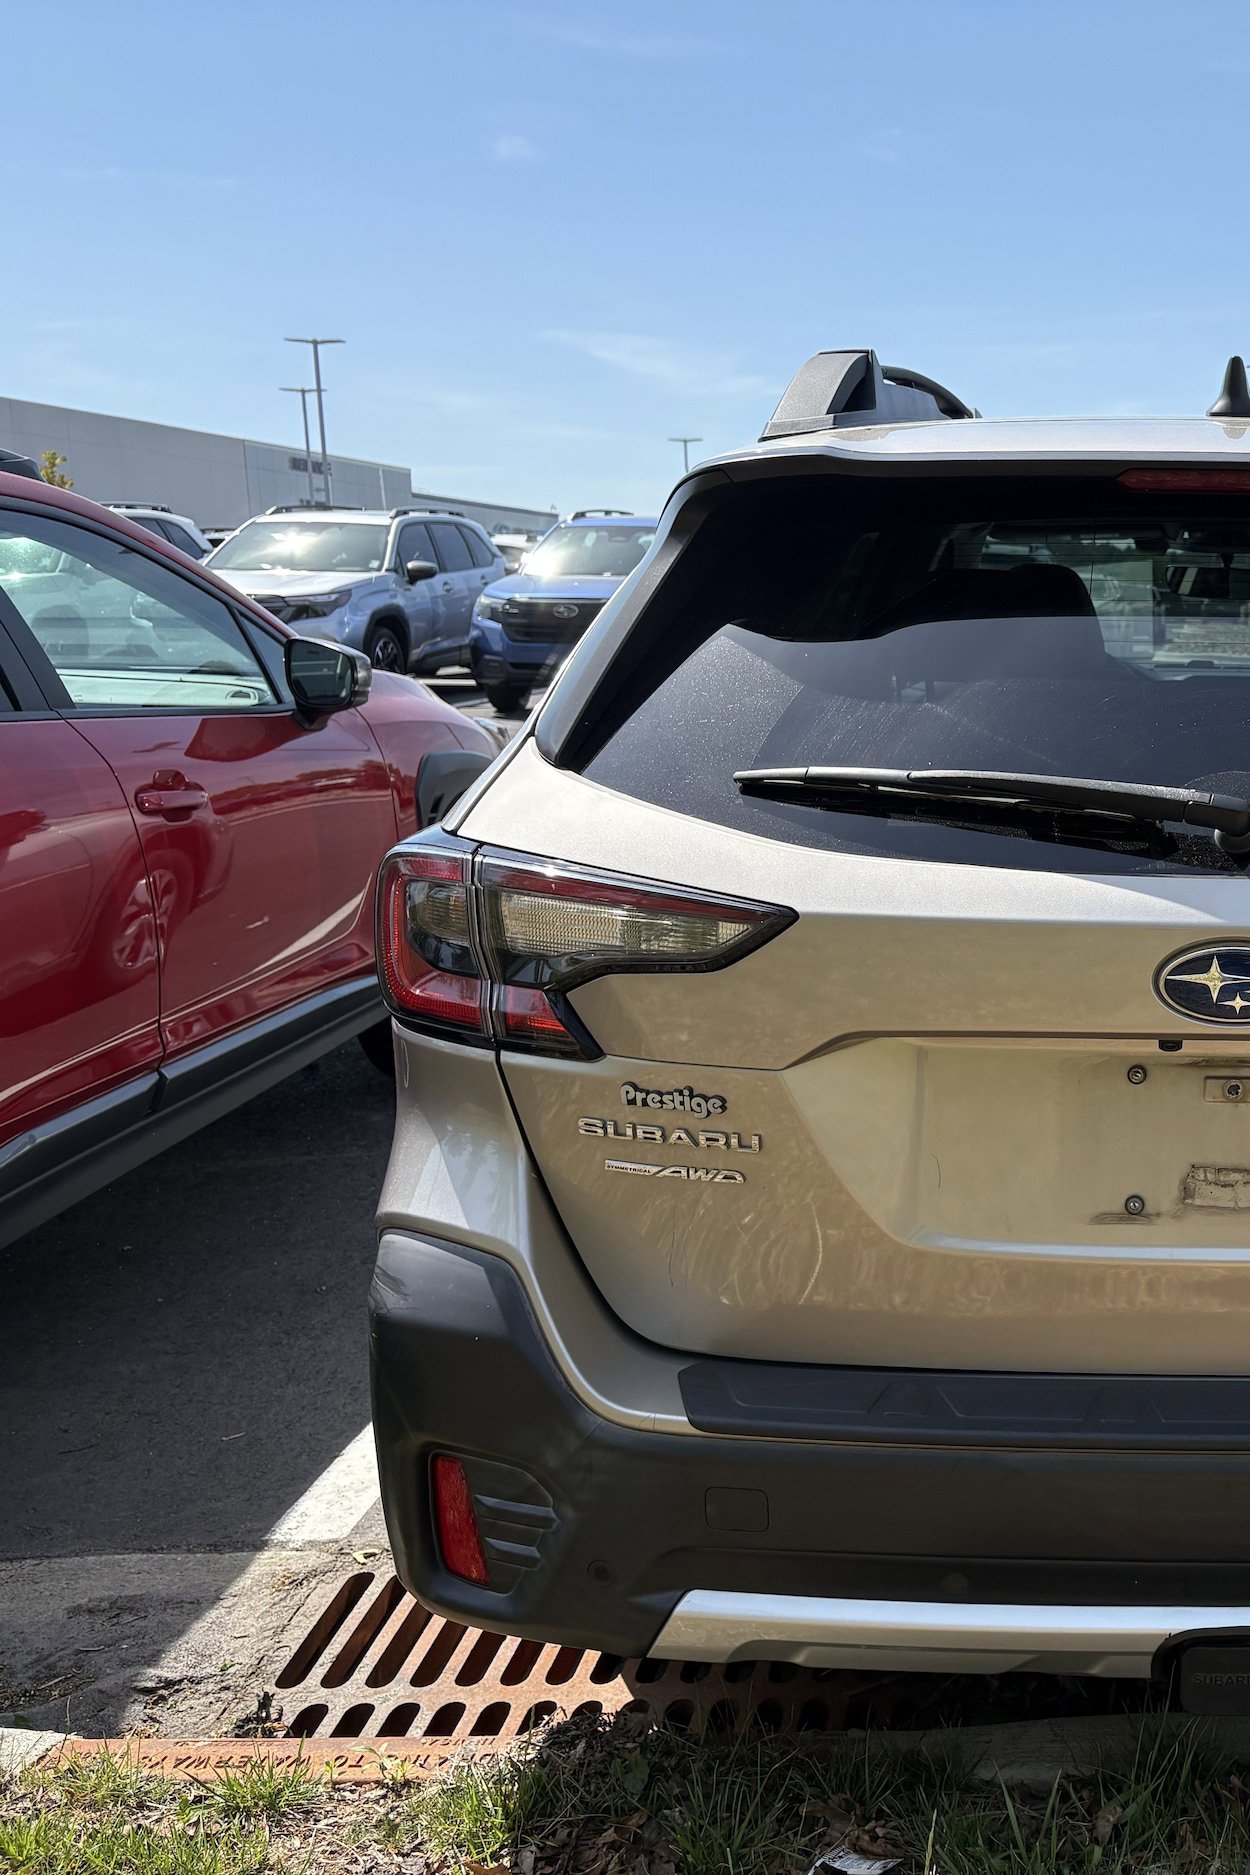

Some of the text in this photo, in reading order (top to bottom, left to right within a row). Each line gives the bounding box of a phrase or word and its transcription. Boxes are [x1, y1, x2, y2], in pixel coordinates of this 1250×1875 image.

[620, 1081, 727, 1119] Prestige
[577, 1117, 761, 1153] SUBARU
[606, 1163, 746, 1184] SYMMETRICAL AWD
[332, 1755, 364, 1768] TO
